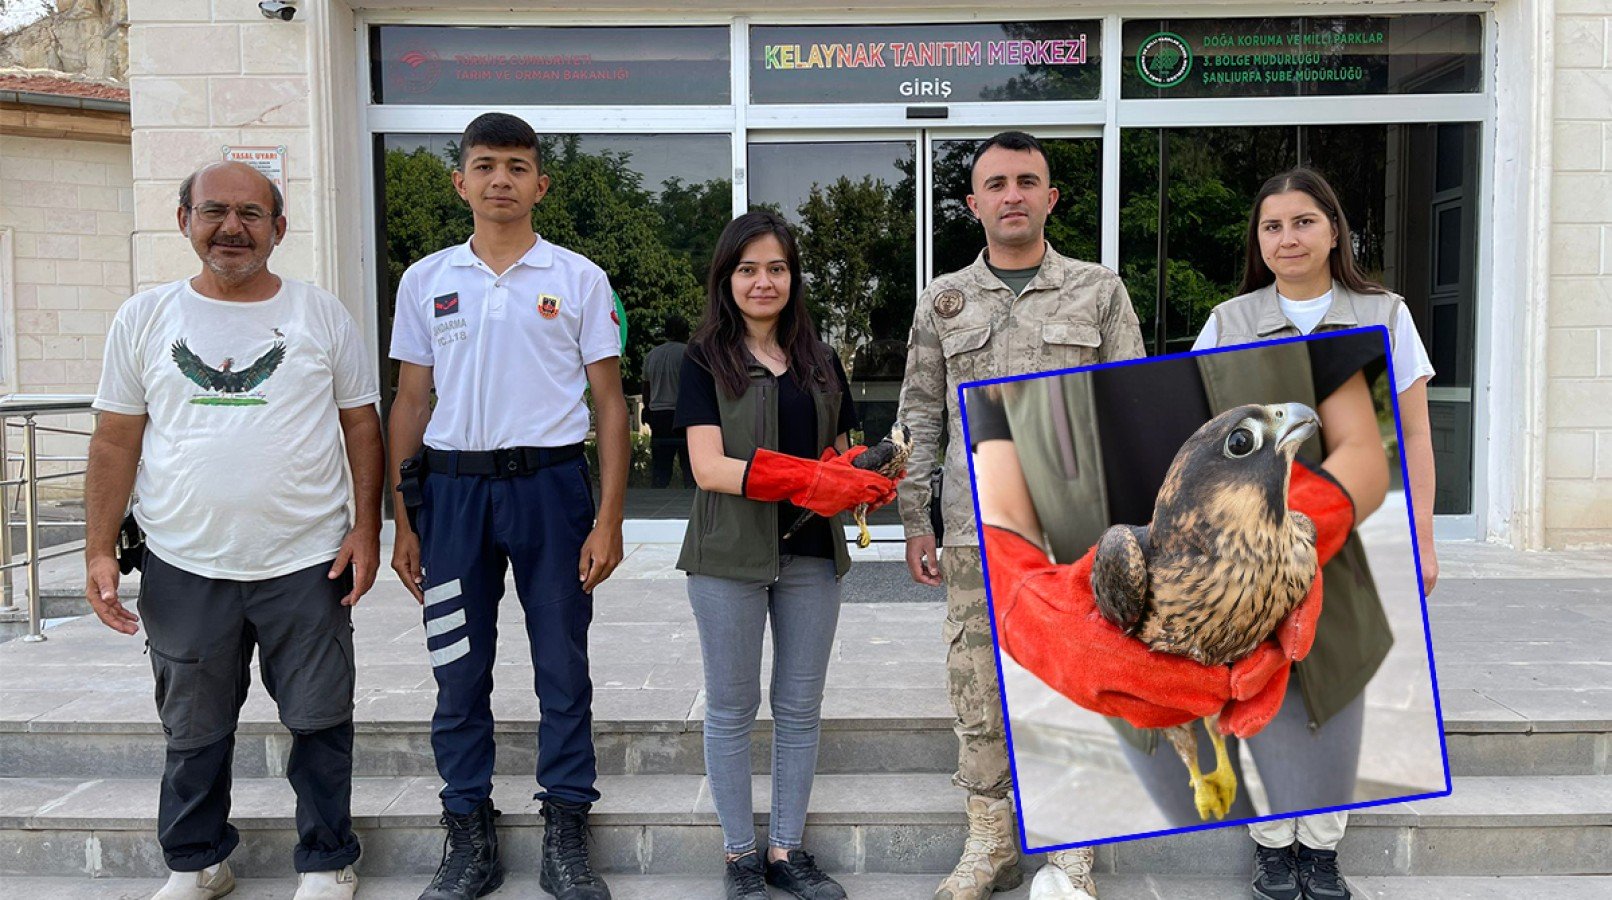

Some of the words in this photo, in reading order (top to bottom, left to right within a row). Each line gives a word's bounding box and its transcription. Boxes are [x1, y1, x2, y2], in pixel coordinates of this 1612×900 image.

[1203, 33, 1234, 47] DOĞA
[1238, 34, 1283, 46] KORUMA
[1287, 34, 1299, 45] VE
[1303, 32, 1332, 45] MİLLİ
[1334, 32, 1383, 45] PARKLAR
[765, 42, 886, 69] KELAYNAK
[890, 41, 982, 67] TANITIM
[987, 34, 1087, 65] MERKEZİ
[1203, 56, 1212, 67] 3.
[1215, 53, 1251, 66] BÖLGE
[1253, 51, 1320, 65] MÜDÜRLÜĞÜ
[456, 70, 492, 80] TARIM
[496, 70, 510, 80] VE
[515, 70, 560, 80] ORMAN
[563, 68, 630, 80] BAKANLIĞI
[1203, 70, 1262, 85] ŞANLIURFA
[1265, 70, 1292, 84] ŞUBE
[1296, 67, 1363, 82] MÜDÜRLÜĞÜ
[899, 77, 952, 98] GİRİŞ
